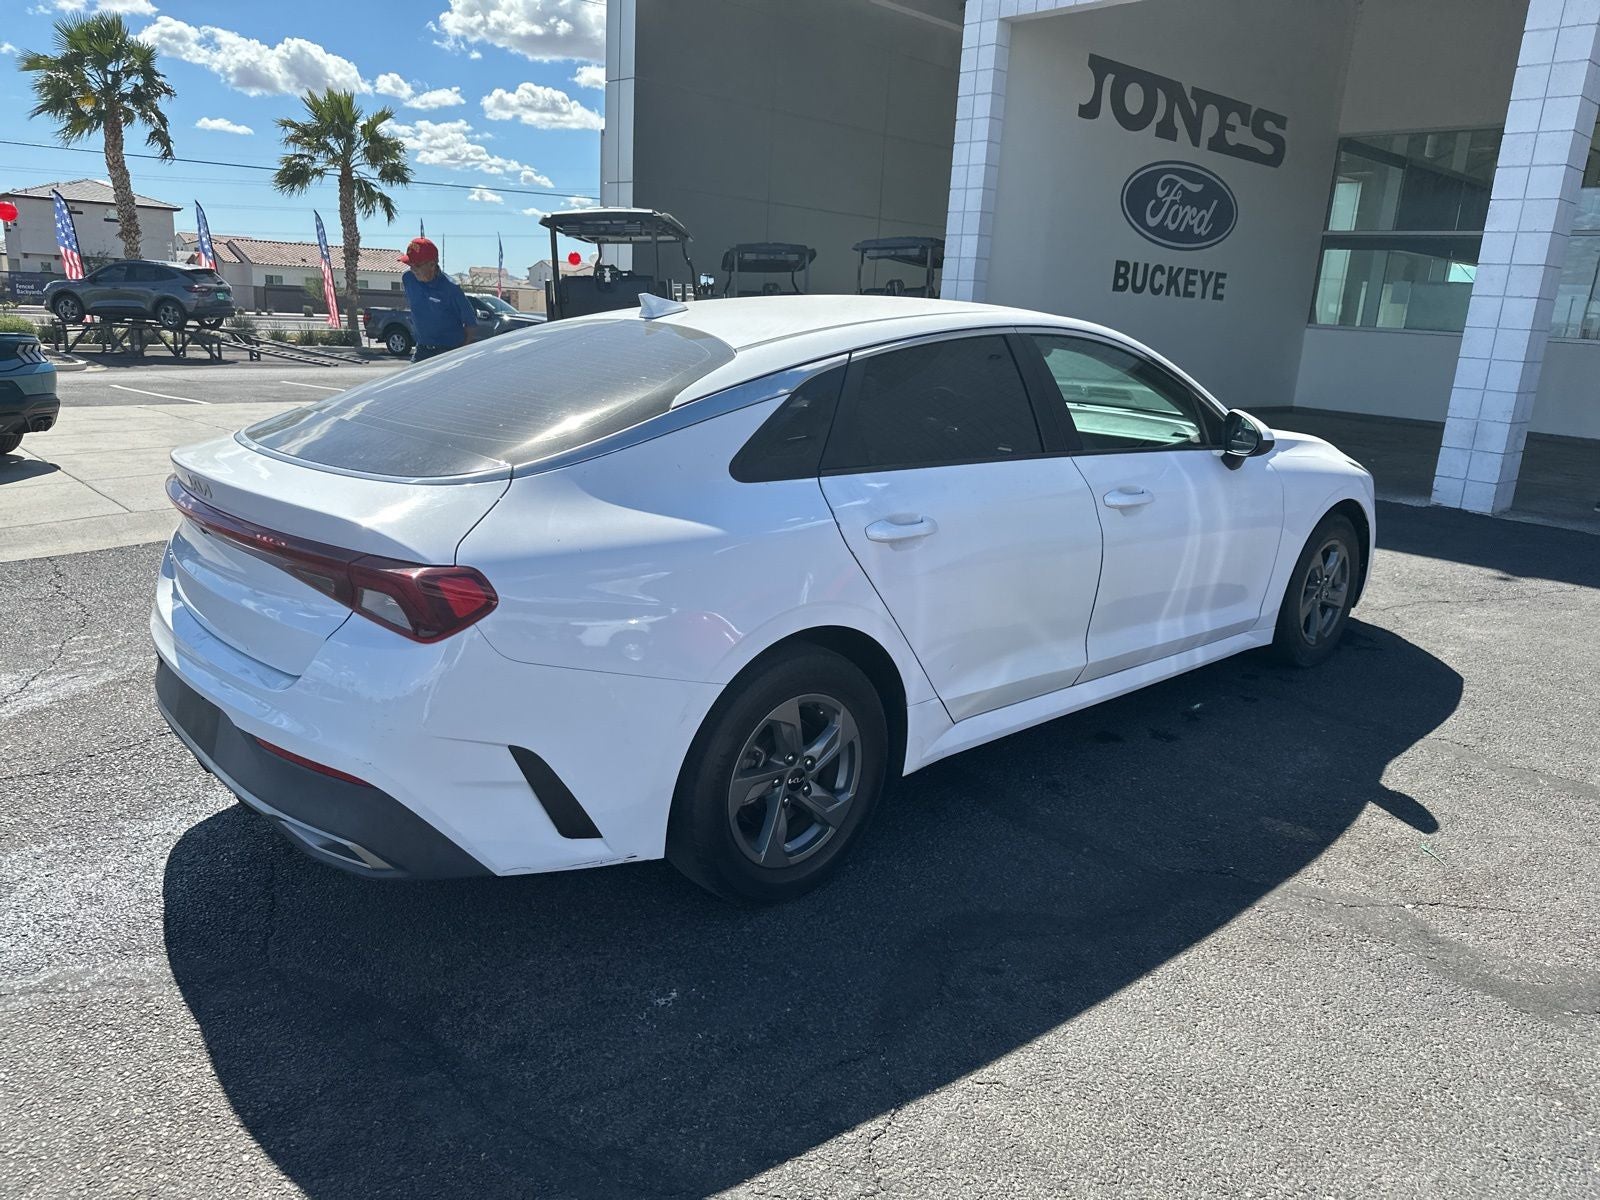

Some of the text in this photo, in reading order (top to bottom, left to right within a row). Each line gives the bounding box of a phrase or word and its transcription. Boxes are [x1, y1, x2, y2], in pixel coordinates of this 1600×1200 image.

[1078, 53, 1288, 168] JONES
[1145, 173, 1218, 237] Ford
[1112, 259, 1227, 301] BUCKEYE
